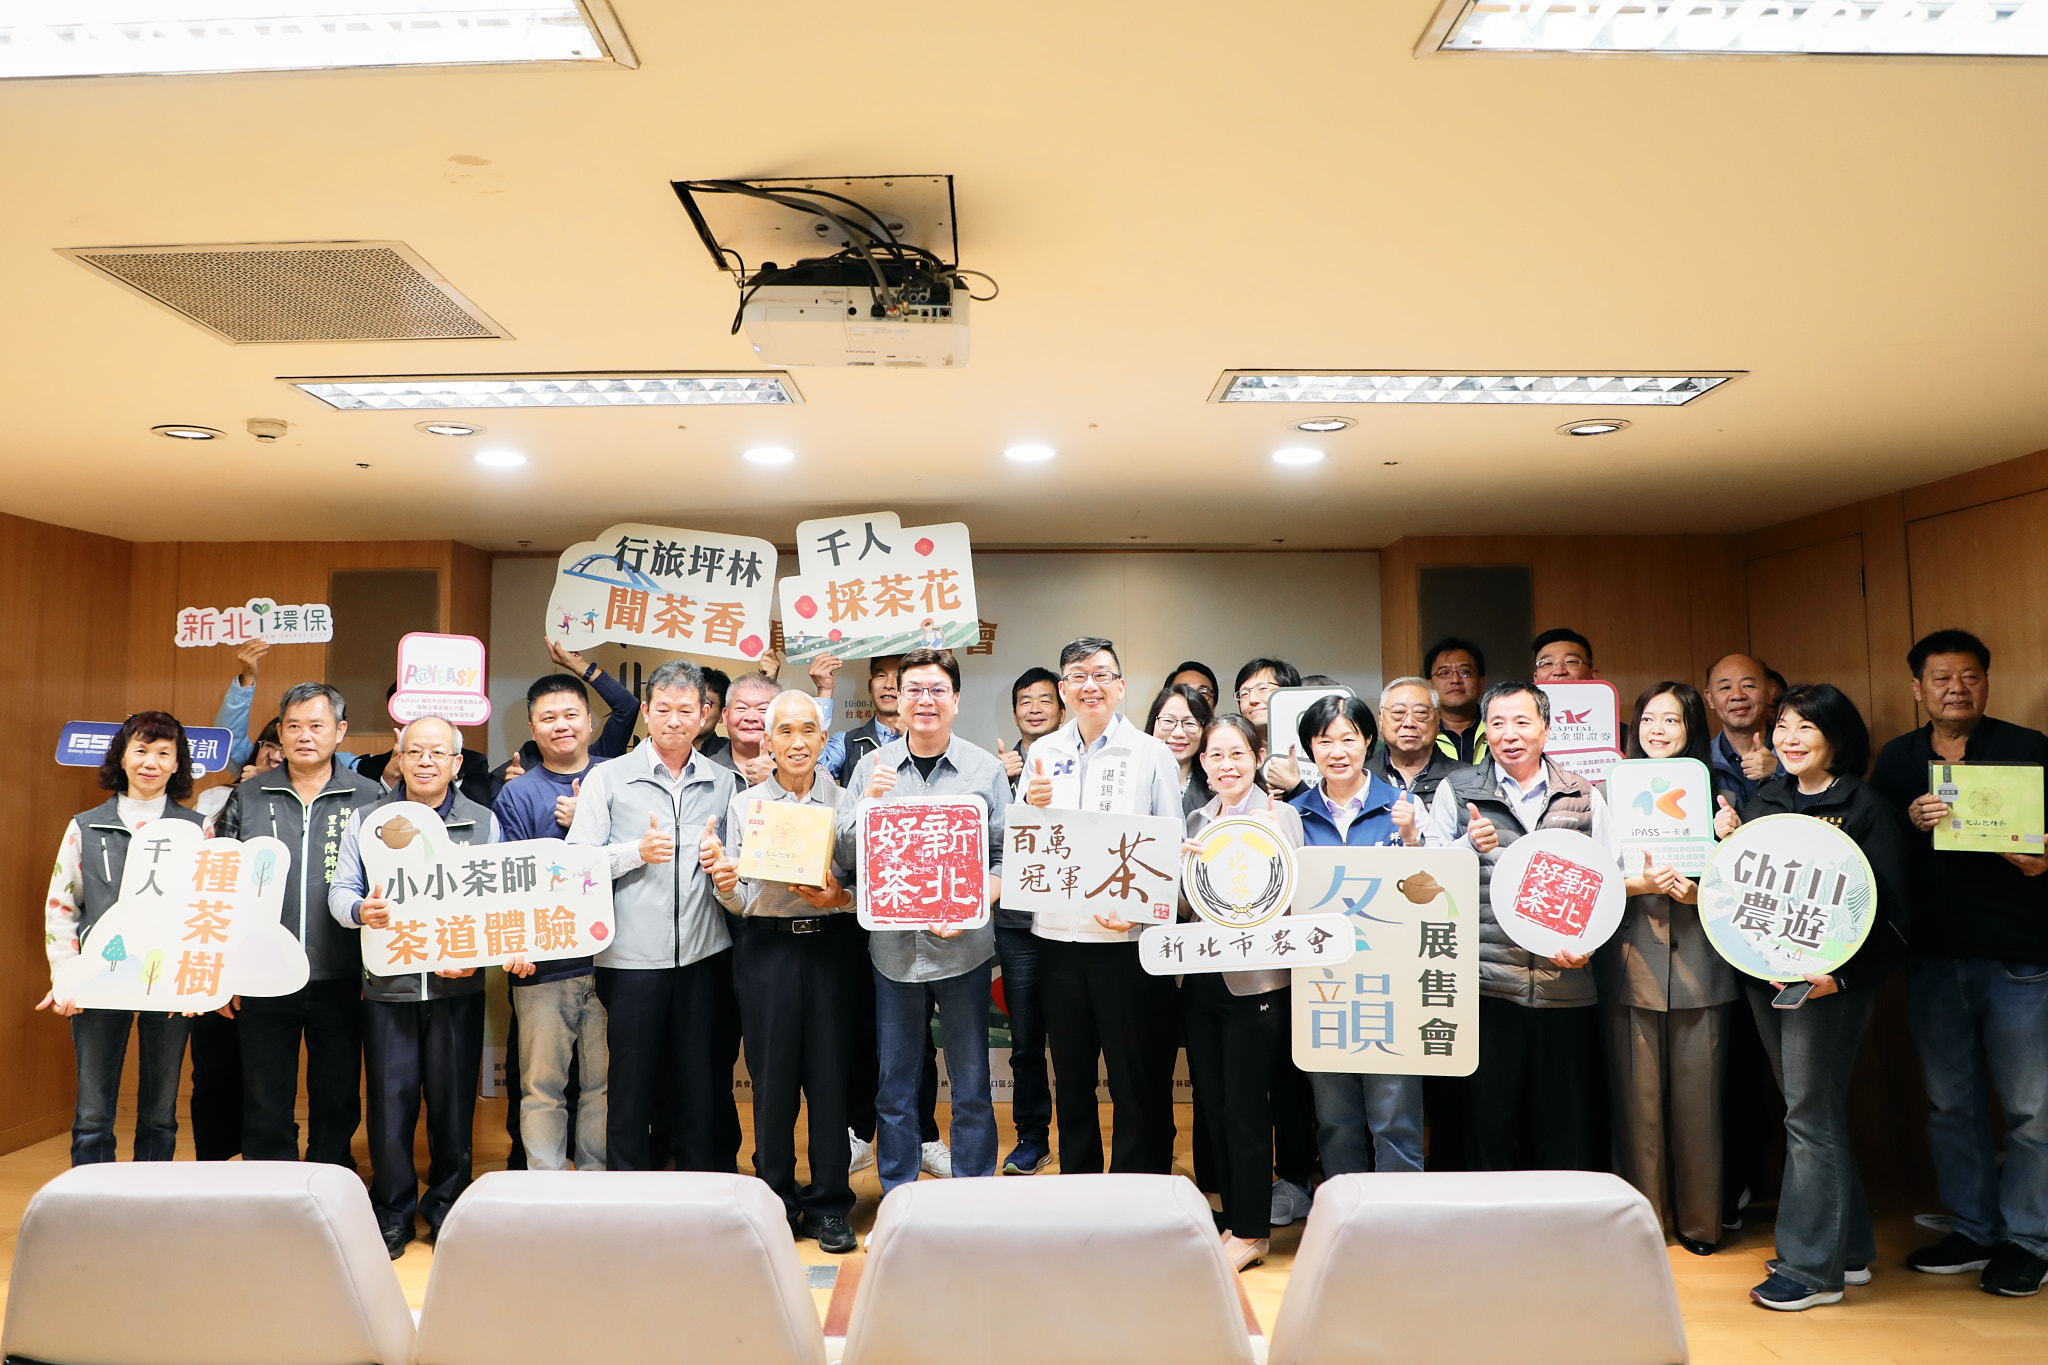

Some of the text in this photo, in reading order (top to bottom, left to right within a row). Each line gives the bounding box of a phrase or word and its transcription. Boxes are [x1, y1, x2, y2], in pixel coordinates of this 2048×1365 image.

[613, 536, 763, 589] 行旅坪林
[816, 521, 892, 568] 千人
[604, 586, 747, 648] 聞茶香
[826, 568, 963, 624] 採茶花
[844, 700, 874, 708] 10:00-1
[845, 710, 877, 719] 台北希
[68, 733, 115, 749] GS
[1009, 824, 1072, 860] 百萬
[1632, 828, 1691, 837] iPASS 一卡通
[135, 837, 172, 897] 千人
[386, 854, 537, 904] 小小茶師
[1019, 865, 1082, 902] 冠軍
[1085, 831, 1173, 905] 茶
[174, 848, 242, 998] 種茶樹
[386, 904, 578, 966] 茶道體驗
[1158, 926, 1334, 962] 新北市農會
[1732, 891, 1829, 950] 農遊
[1418, 919, 1459, 1057] 展售會
